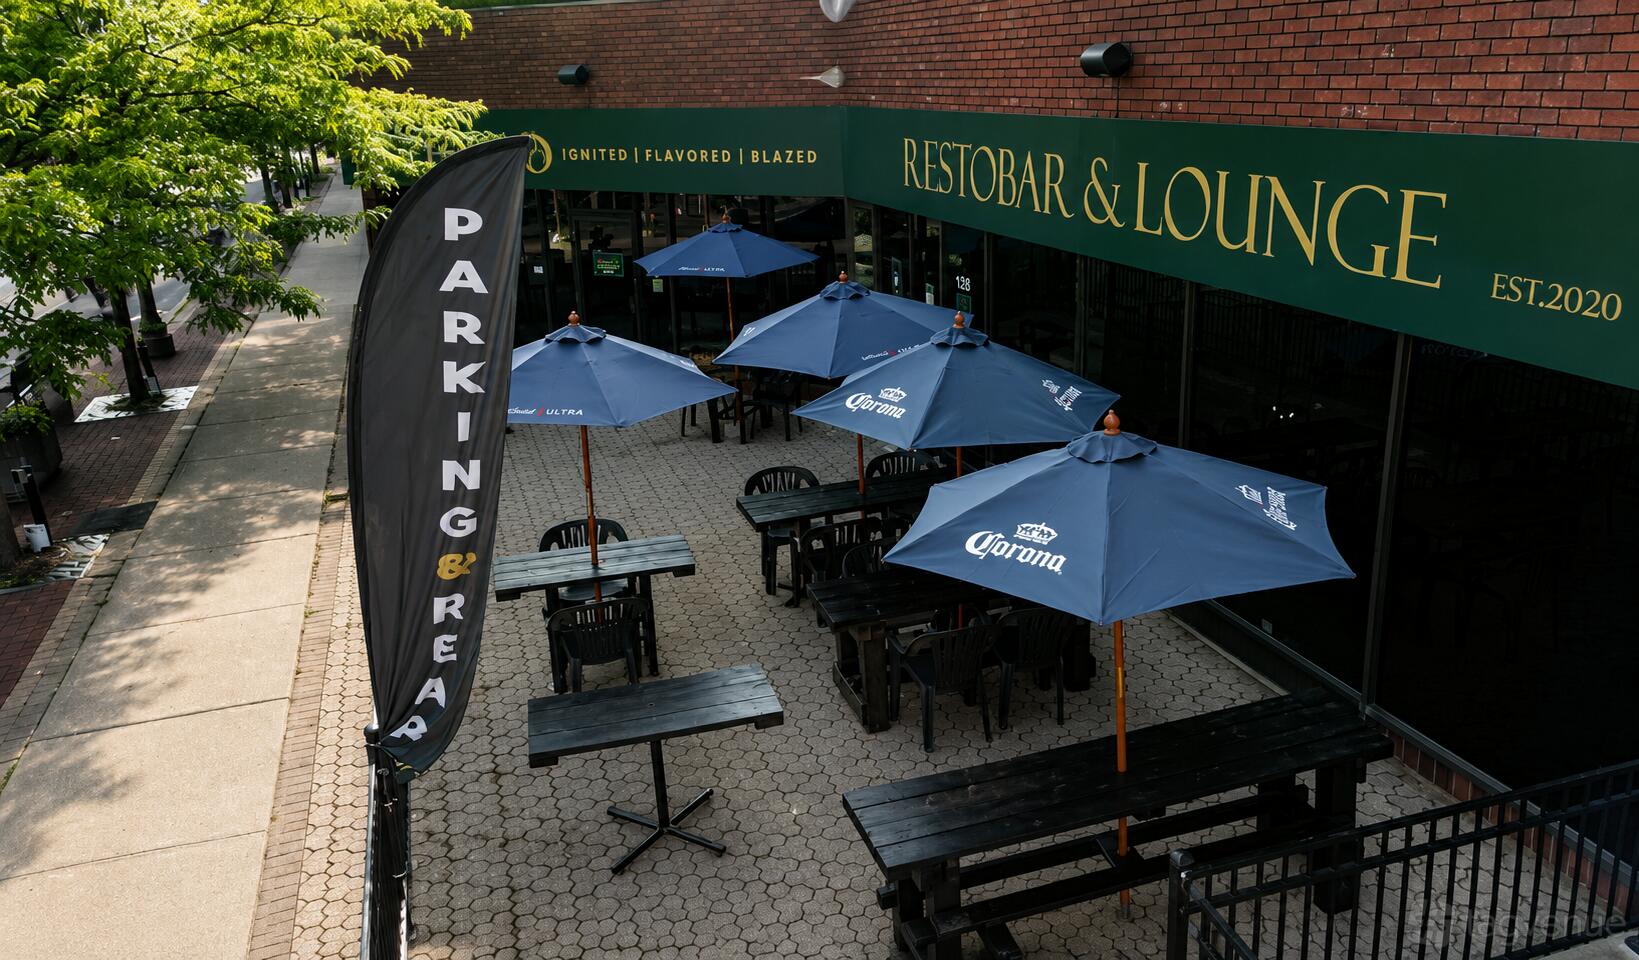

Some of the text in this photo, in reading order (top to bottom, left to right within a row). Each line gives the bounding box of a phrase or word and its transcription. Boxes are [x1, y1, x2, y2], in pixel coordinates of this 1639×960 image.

[561, 148, 818, 164] IGNITED FLAVORED BLAZED
[903, 137, 1448, 289] RESTOBAR & LOUNGE
[955, 275, 971, 292] 128
[1490, 272, 1623, 322] EST.2020
[546, 408, 584, 416] ULTRA
[845, 392, 907, 419] Corona
[389, 207, 489, 742] PARKING & REAR
[964, 530, 1067, 575] Corona
